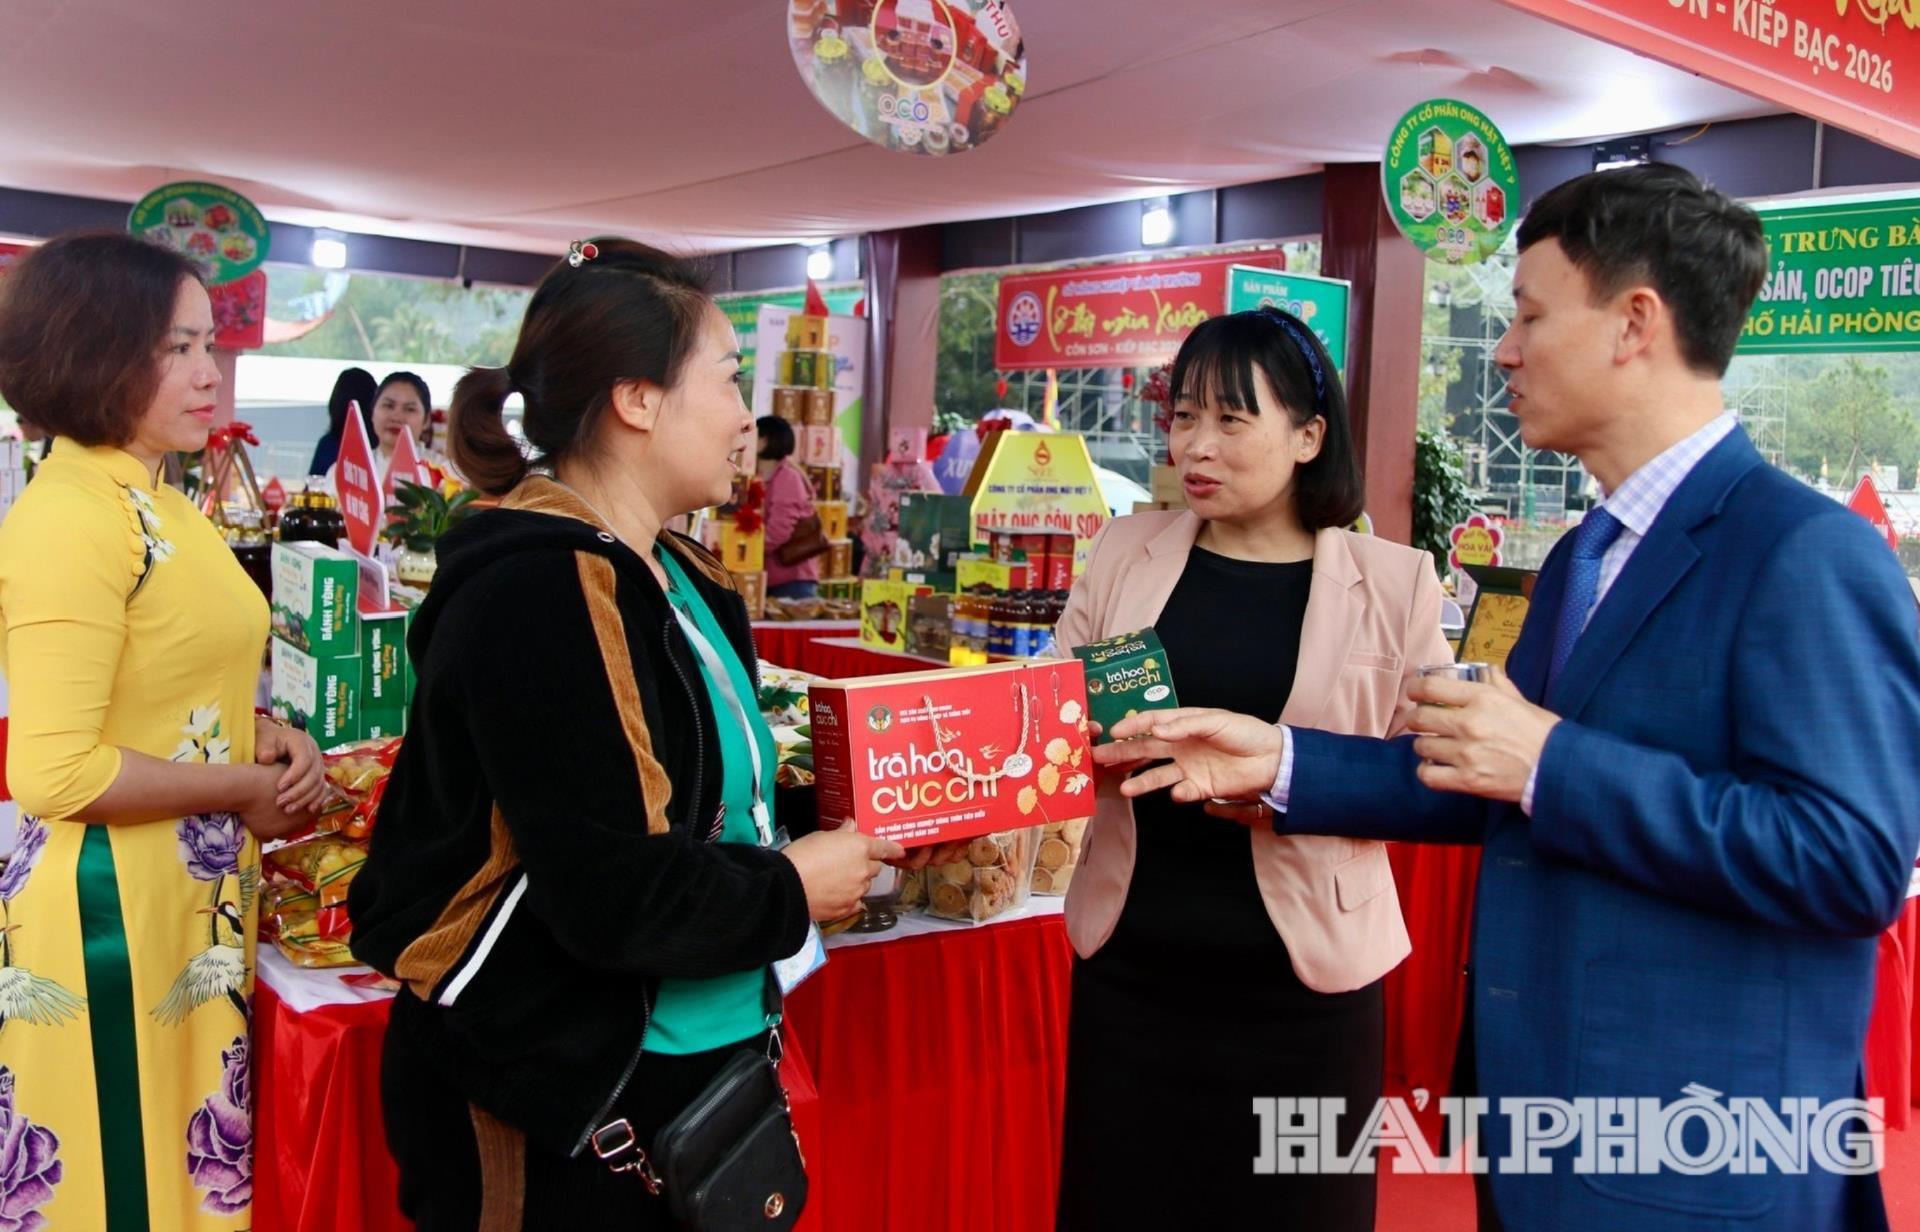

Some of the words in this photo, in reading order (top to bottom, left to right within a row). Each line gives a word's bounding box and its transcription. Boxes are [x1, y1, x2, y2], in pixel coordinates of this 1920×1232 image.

[1794, 20, 1840, 75] BẠC
[1844, 43, 1894, 94] 2026
[1780, 226, 1880, 254] TRƯNG
[1814, 265, 1874, 300] OCOP
[1780, 308, 1822, 336] HẢI
[1828, 306, 1920, 335] PHÒNG
[320, 609, 333, 641] BÁNH
[323, 707, 336, 738] BÁNH
[909, 742, 964, 777] hoa
[871, 779, 943, 815] cúc
[945, 757, 998, 803] chi
